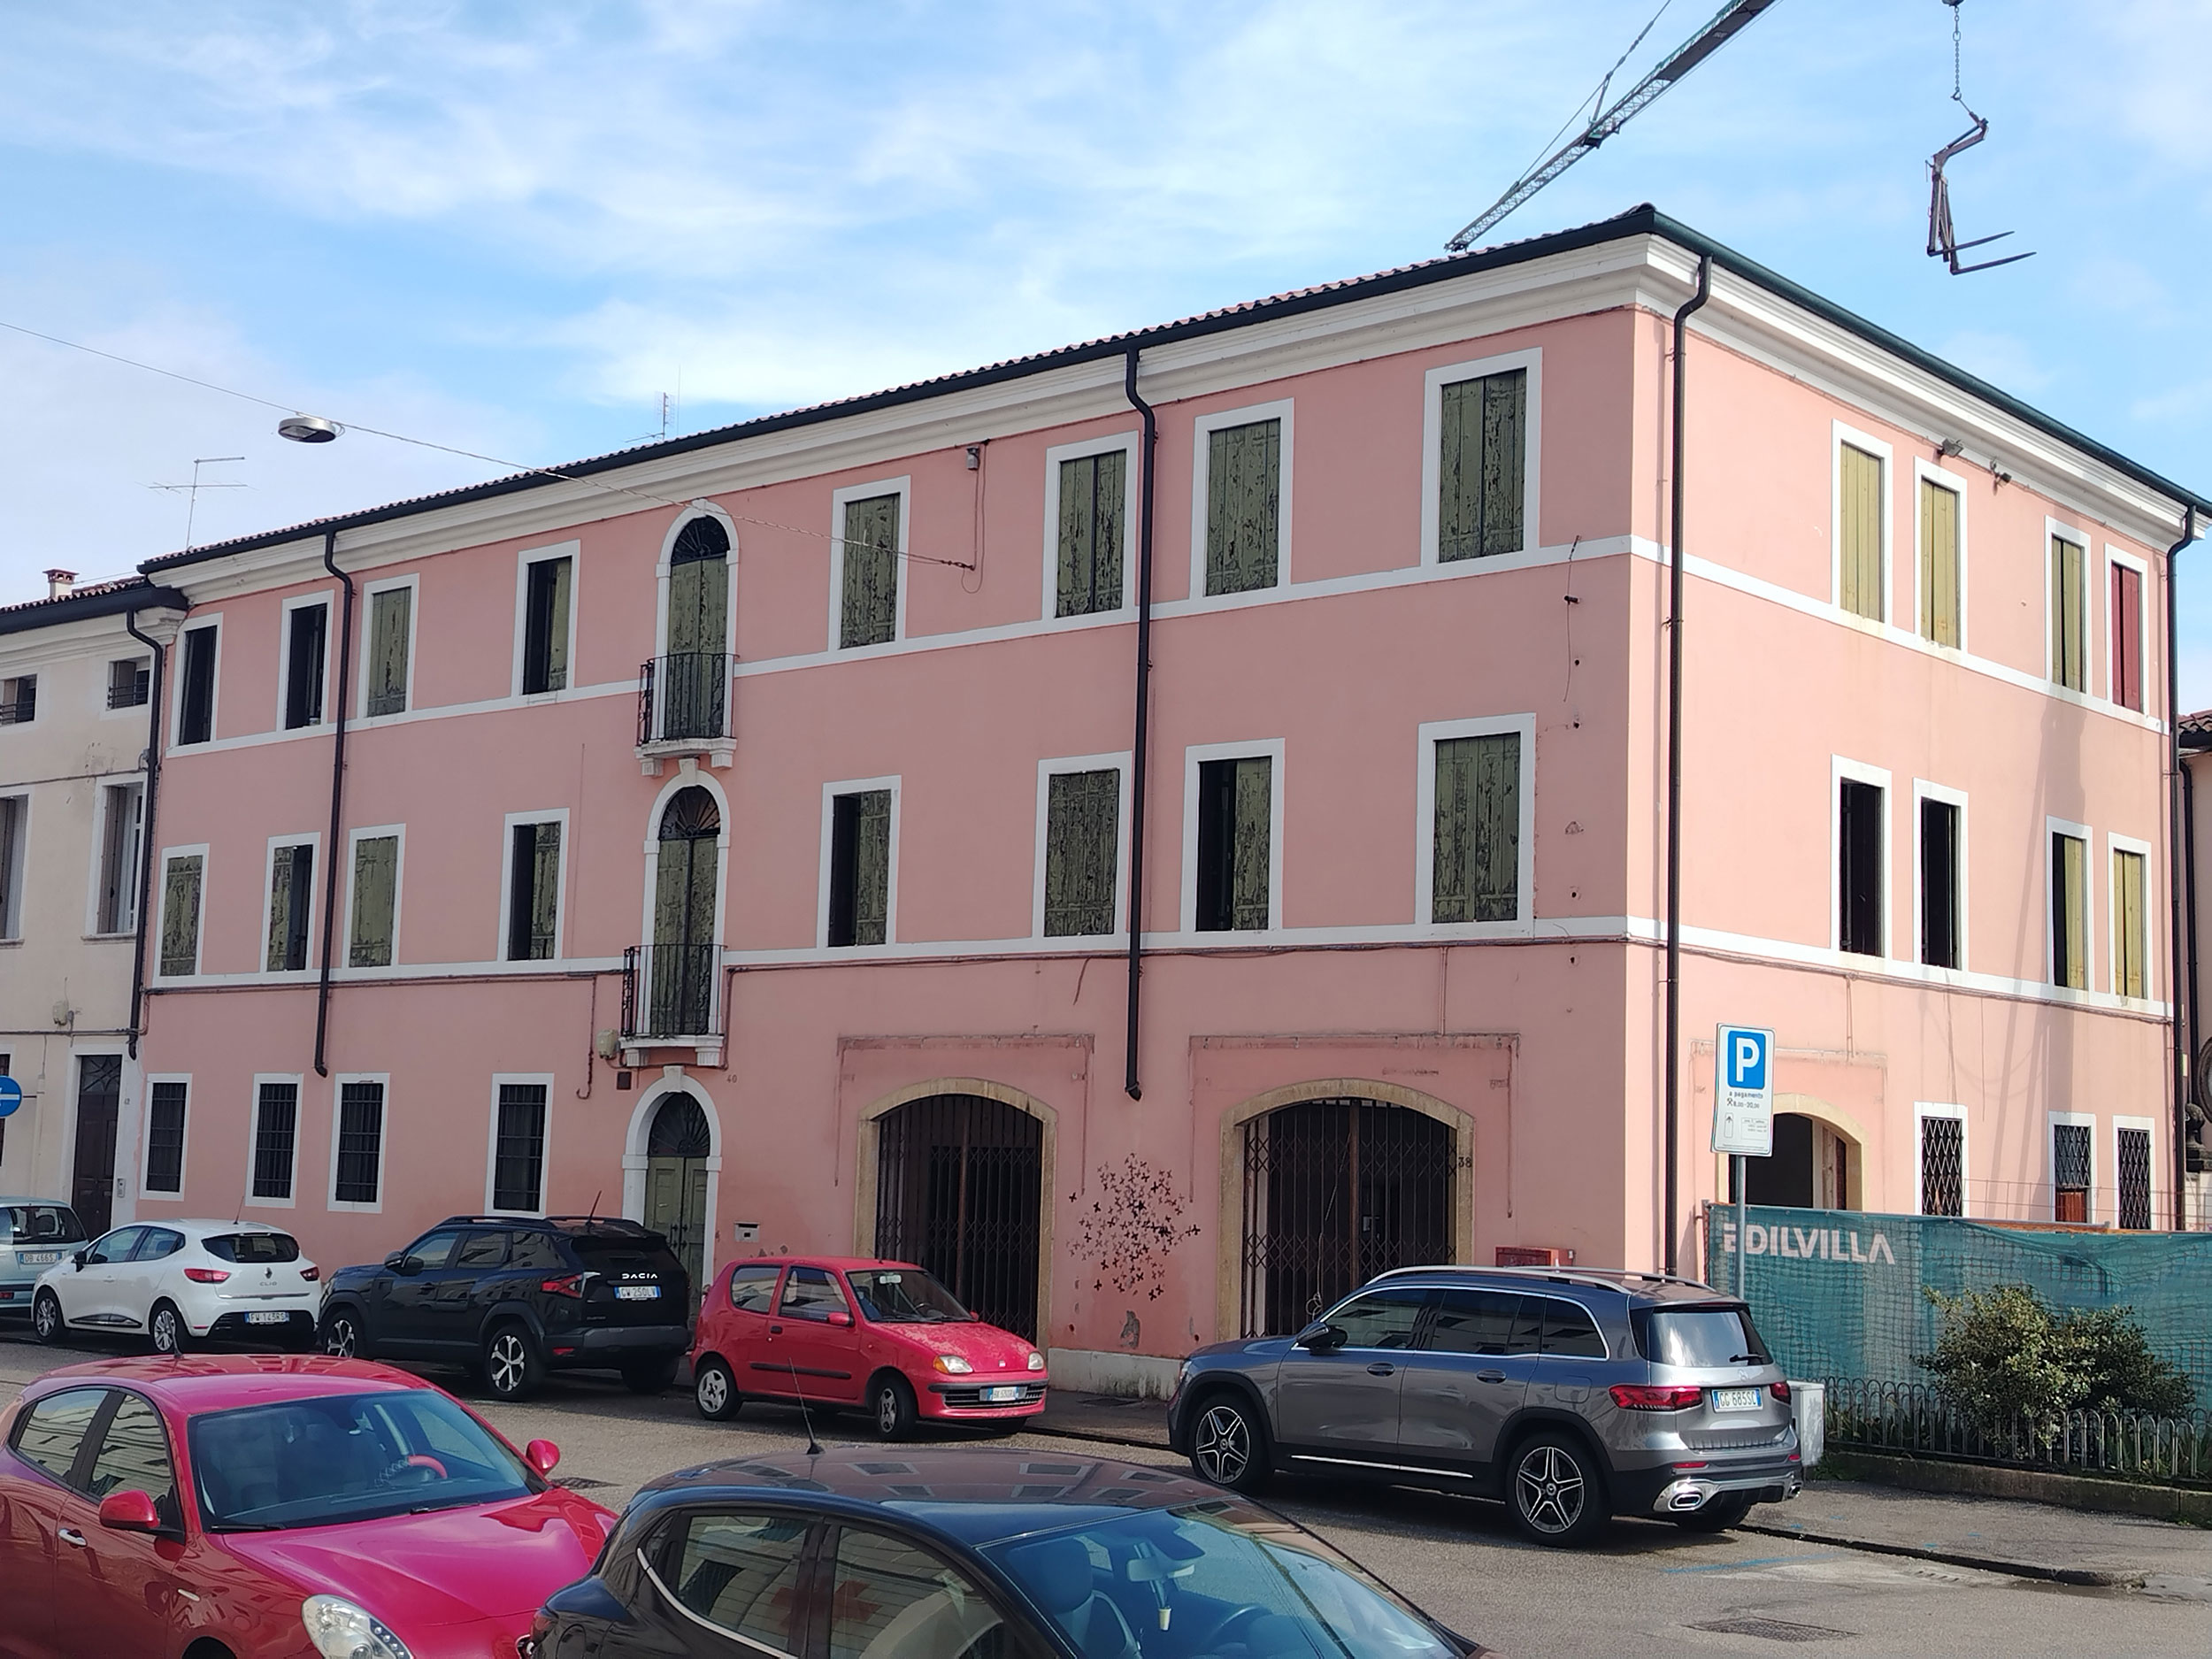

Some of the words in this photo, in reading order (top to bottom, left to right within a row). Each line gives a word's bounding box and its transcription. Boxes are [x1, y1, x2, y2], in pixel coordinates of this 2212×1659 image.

[1736, 1037, 1760, 1082] P
[726, 1074, 738, 1084] 40
[1458, 1156, 1472, 1168] 38
[1724, 1223, 1895, 1264] EDILVILLA
[1732, 1391, 1756, 1406] 685SC
